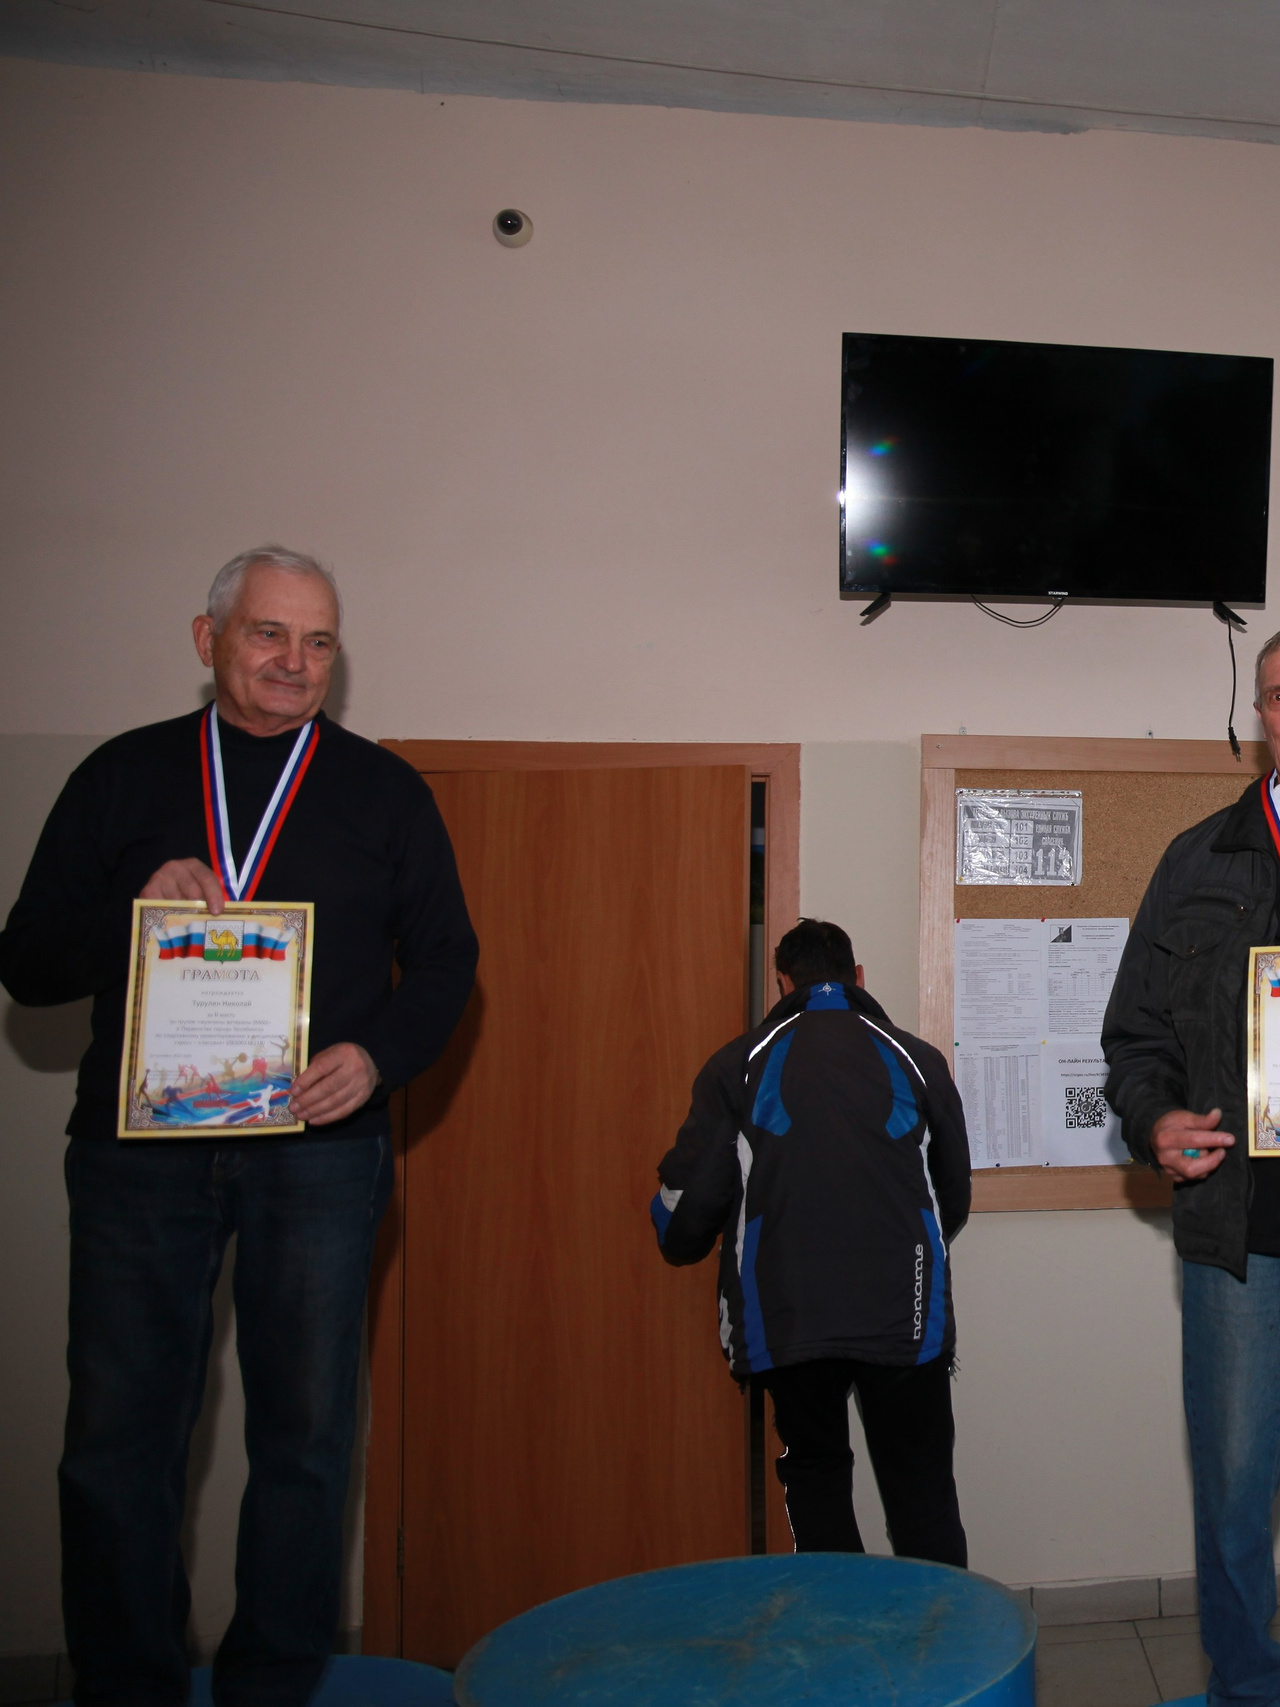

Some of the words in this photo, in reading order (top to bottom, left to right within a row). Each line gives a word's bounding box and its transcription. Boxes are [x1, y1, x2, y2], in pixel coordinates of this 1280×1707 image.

[1015, 822, 1028, 831] 101
[1015, 837, 1029, 845] 102
[1015, 851, 1028, 860] 103
[1015, 865, 1028, 875] 104
[182, 969, 260, 980] ГРАМОТА
[193, 1000, 221, 1008] Турулин
[222, 999, 252, 1008] Николай
[913, 1244, 924, 1340] noname
